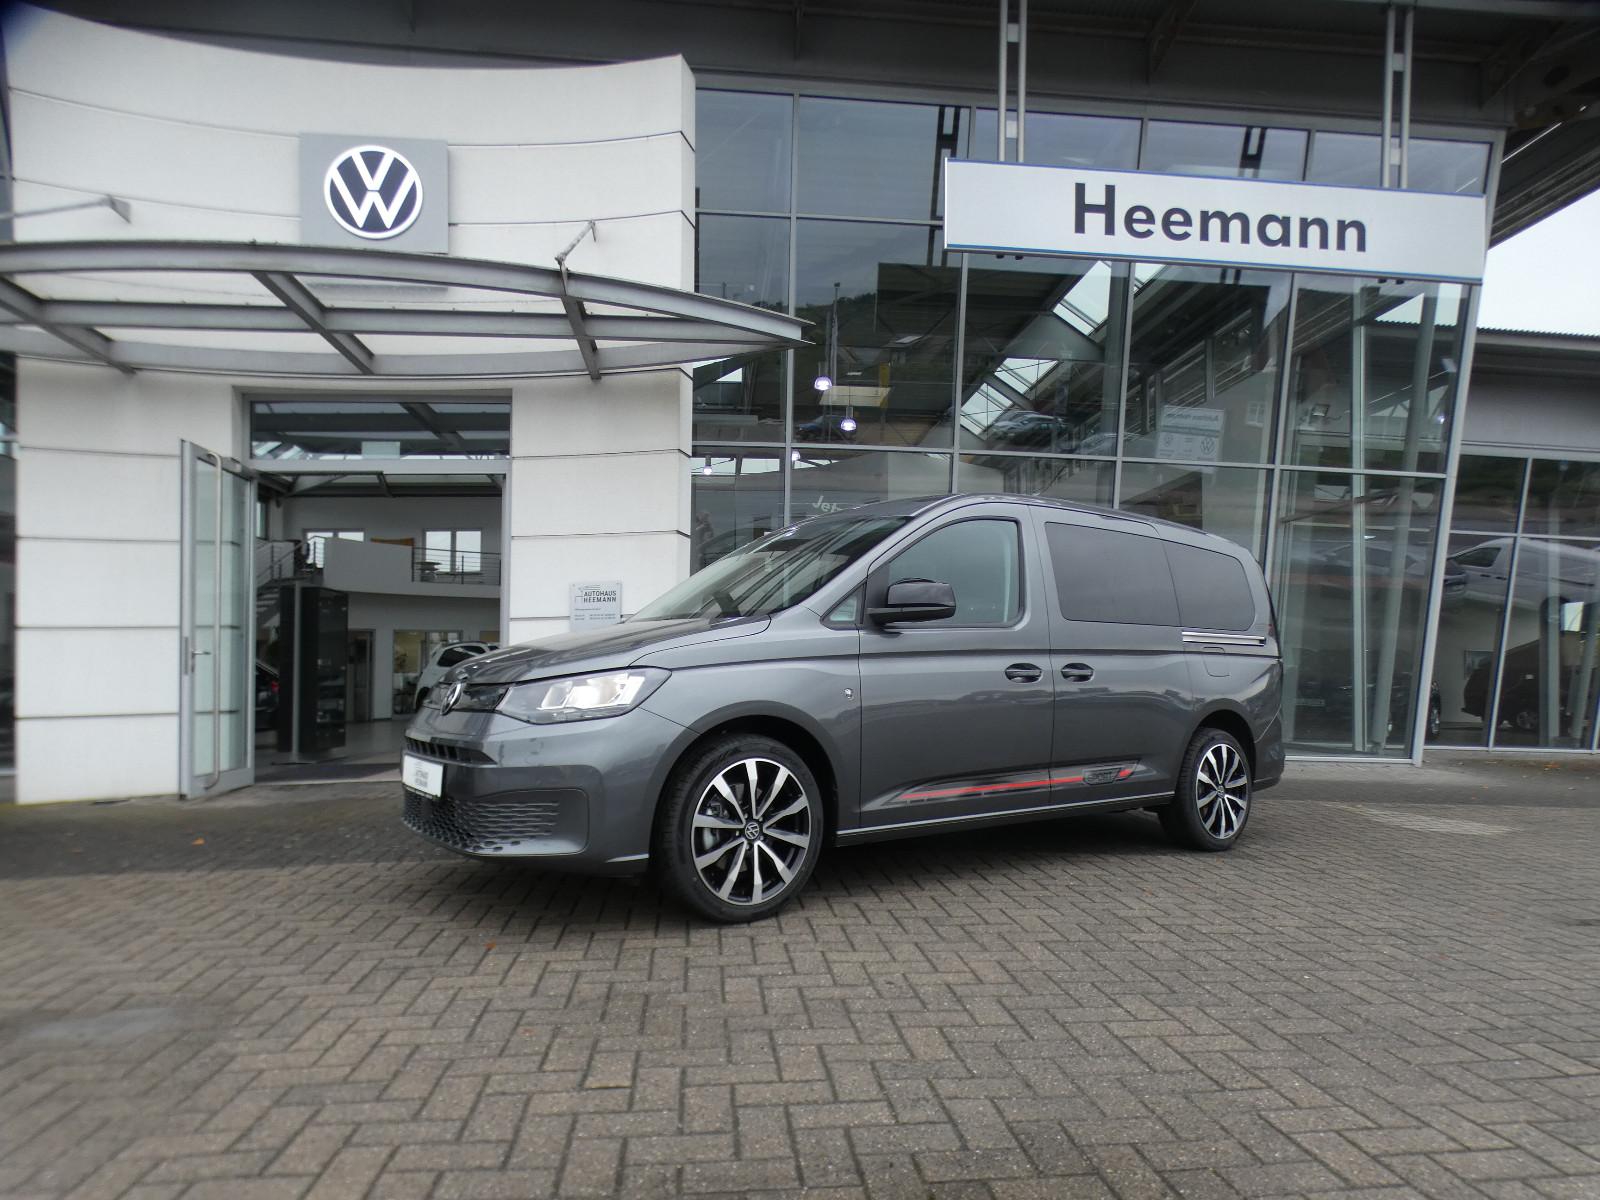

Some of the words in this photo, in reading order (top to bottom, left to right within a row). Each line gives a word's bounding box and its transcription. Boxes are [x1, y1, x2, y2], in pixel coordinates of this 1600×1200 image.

[325, 146, 422, 238] VW
[1074, 182, 1366, 253] Heemann
[812, 495, 842, 512] Jet
